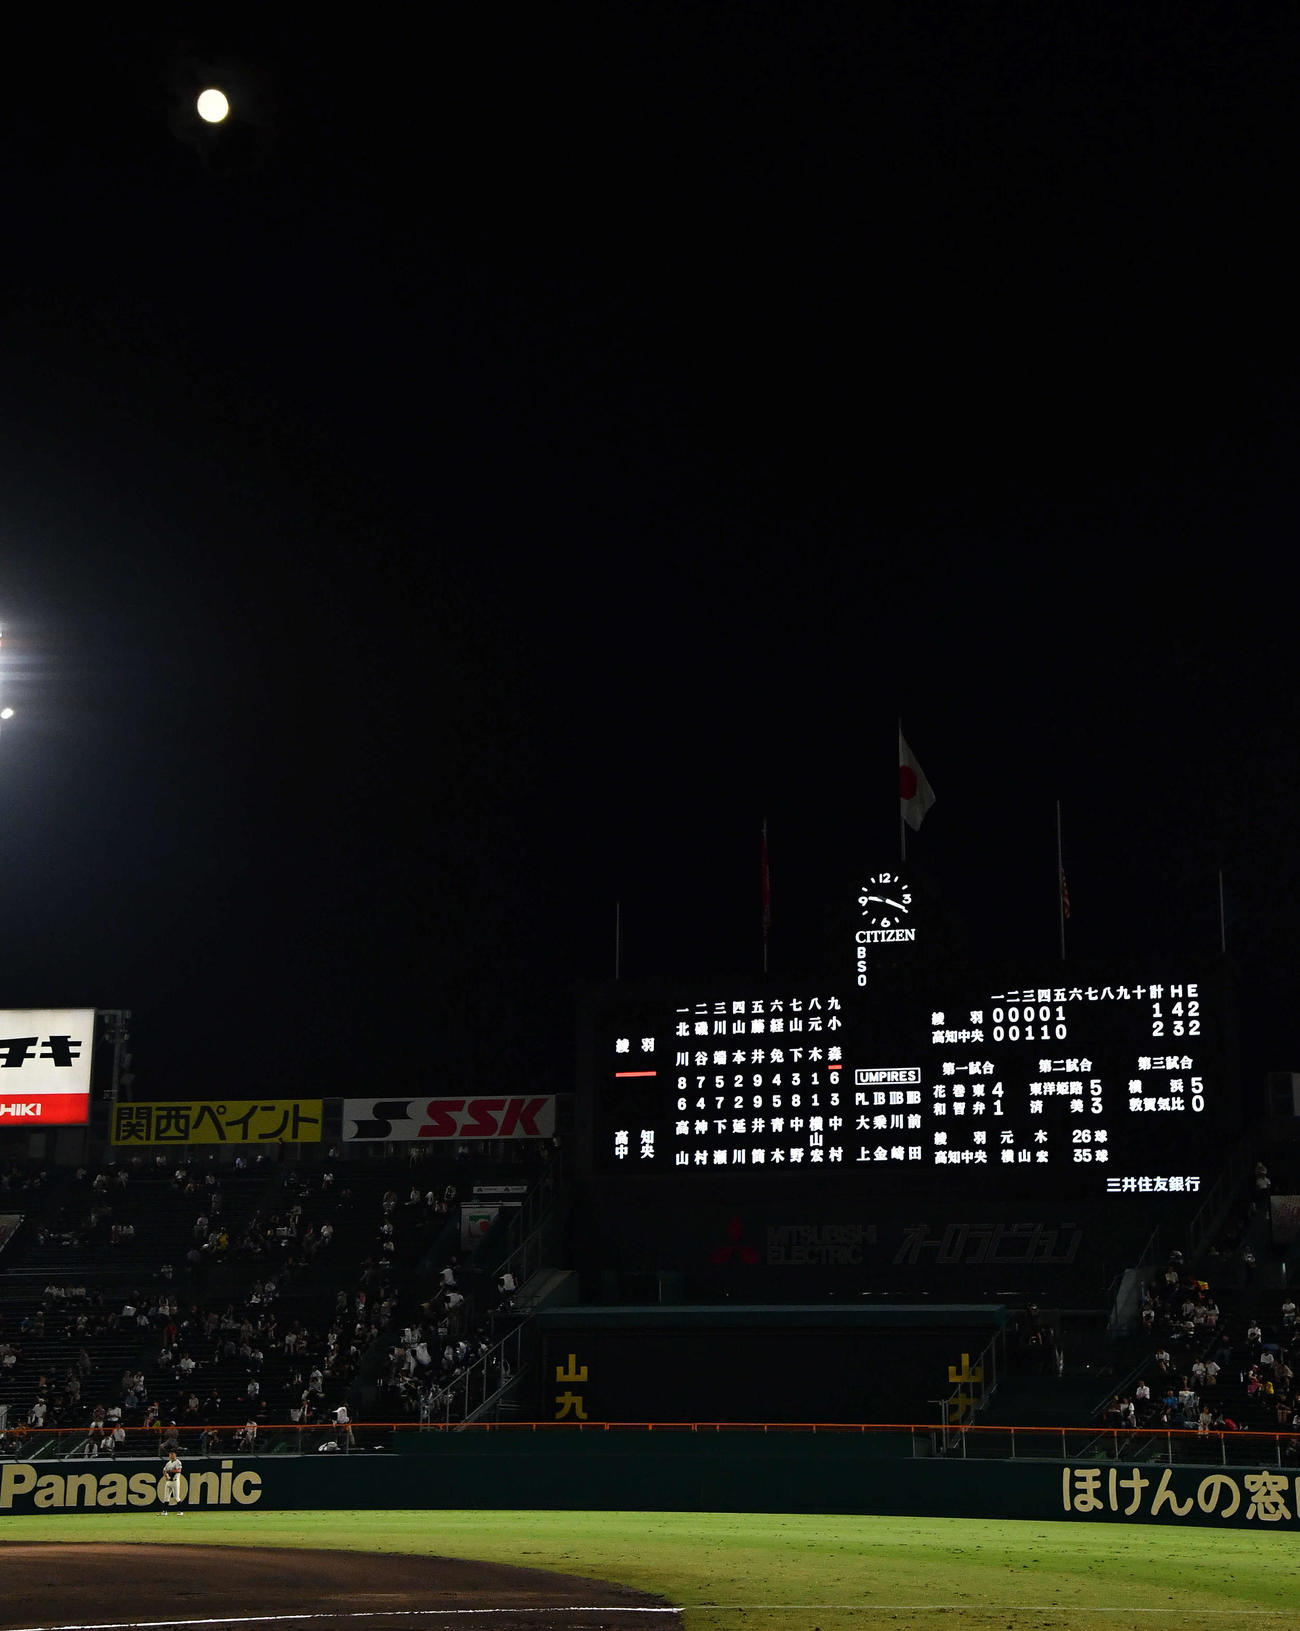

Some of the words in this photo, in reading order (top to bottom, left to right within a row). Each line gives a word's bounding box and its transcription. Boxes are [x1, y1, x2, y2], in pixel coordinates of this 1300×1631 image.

[879, 873, 890, 883] 12
[858, 896, 867, 906] 9
[902, 894, 911, 904] 3
[881, 918, 890, 927] 6
[855, 929, 915, 943] CITIZEN
[857, 947, 866, 958] B
[857, 961, 866, 972] S
[1171, 985, 1182, 998] H
[1187, 984, 1198, 997] E
[1153, 1003, 1162, 1017] 1
[1172, 1002, 1184, 1016] 4
[1188, 1001, 1199, 1016] 2
[932, 1029, 984, 1044] 高知中央
[1153, 1021, 1164, 1036] 2
[1173, 1021, 1184, 1036] 3
[1189, 1020, 1200, 1035] 2
[943, 1061, 994, 1075] 第一試合
[1039, 1058, 1092, 1073] 第二試合
[1138, 1056, 1193, 1070] 第三試合
[678, 1077, 686, 1089] 8
[697, 1076, 705, 1088] 7
[716, 1076, 724, 1088] 5
[734, 1075, 743, 1087] 2
[753, 1074, 762, 1087] 9
[772, 1074, 781, 1086] 4
[792, 1073, 800, 1085] 3
[812, 1073, 819, 1085] 1
[830, 1072, 839, 1084] 6
[860, 1071, 918, 1083] UMPIRES
[992, 1082, 1004, 1097] 4
[1029, 1081, 1083, 1096] 東洋姫路
[1090, 1079, 1102, 1096] 5
[1191, 1077, 1203, 1093] 5
[678, 1098, 686, 1110] 6
[696, 1097, 705, 1109] 4
[716, 1097, 724, 1109] 7
[734, 1096, 743, 1108] 2
[753, 1095, 762, 1108] 9
[773, 1095, 781, 1107] 5
[792, 1094, 800, 1107] 8
[812, 1094, 819, 1106] 1
[831, 1093, 839, 1106] 3
[994, 1100, 1003, 1115] 1
[1091, 1097, 1102, 1114] 3
[1129, 1097, 1185, 1111] 敦賀気比
[1192, 1095, 1204, 1112] 0
[115, 1105, 322, 1143] 関西ペイント
[418, 1097, 550, 1136] SSK
[935, 1150, 987, 1164] 高知中央
[1107, 1176, 1200, 1192] 三井住友銀行
[555, 1353, 589, 1419] 山九
[0, 1460, 263, 1509] Panasonic
